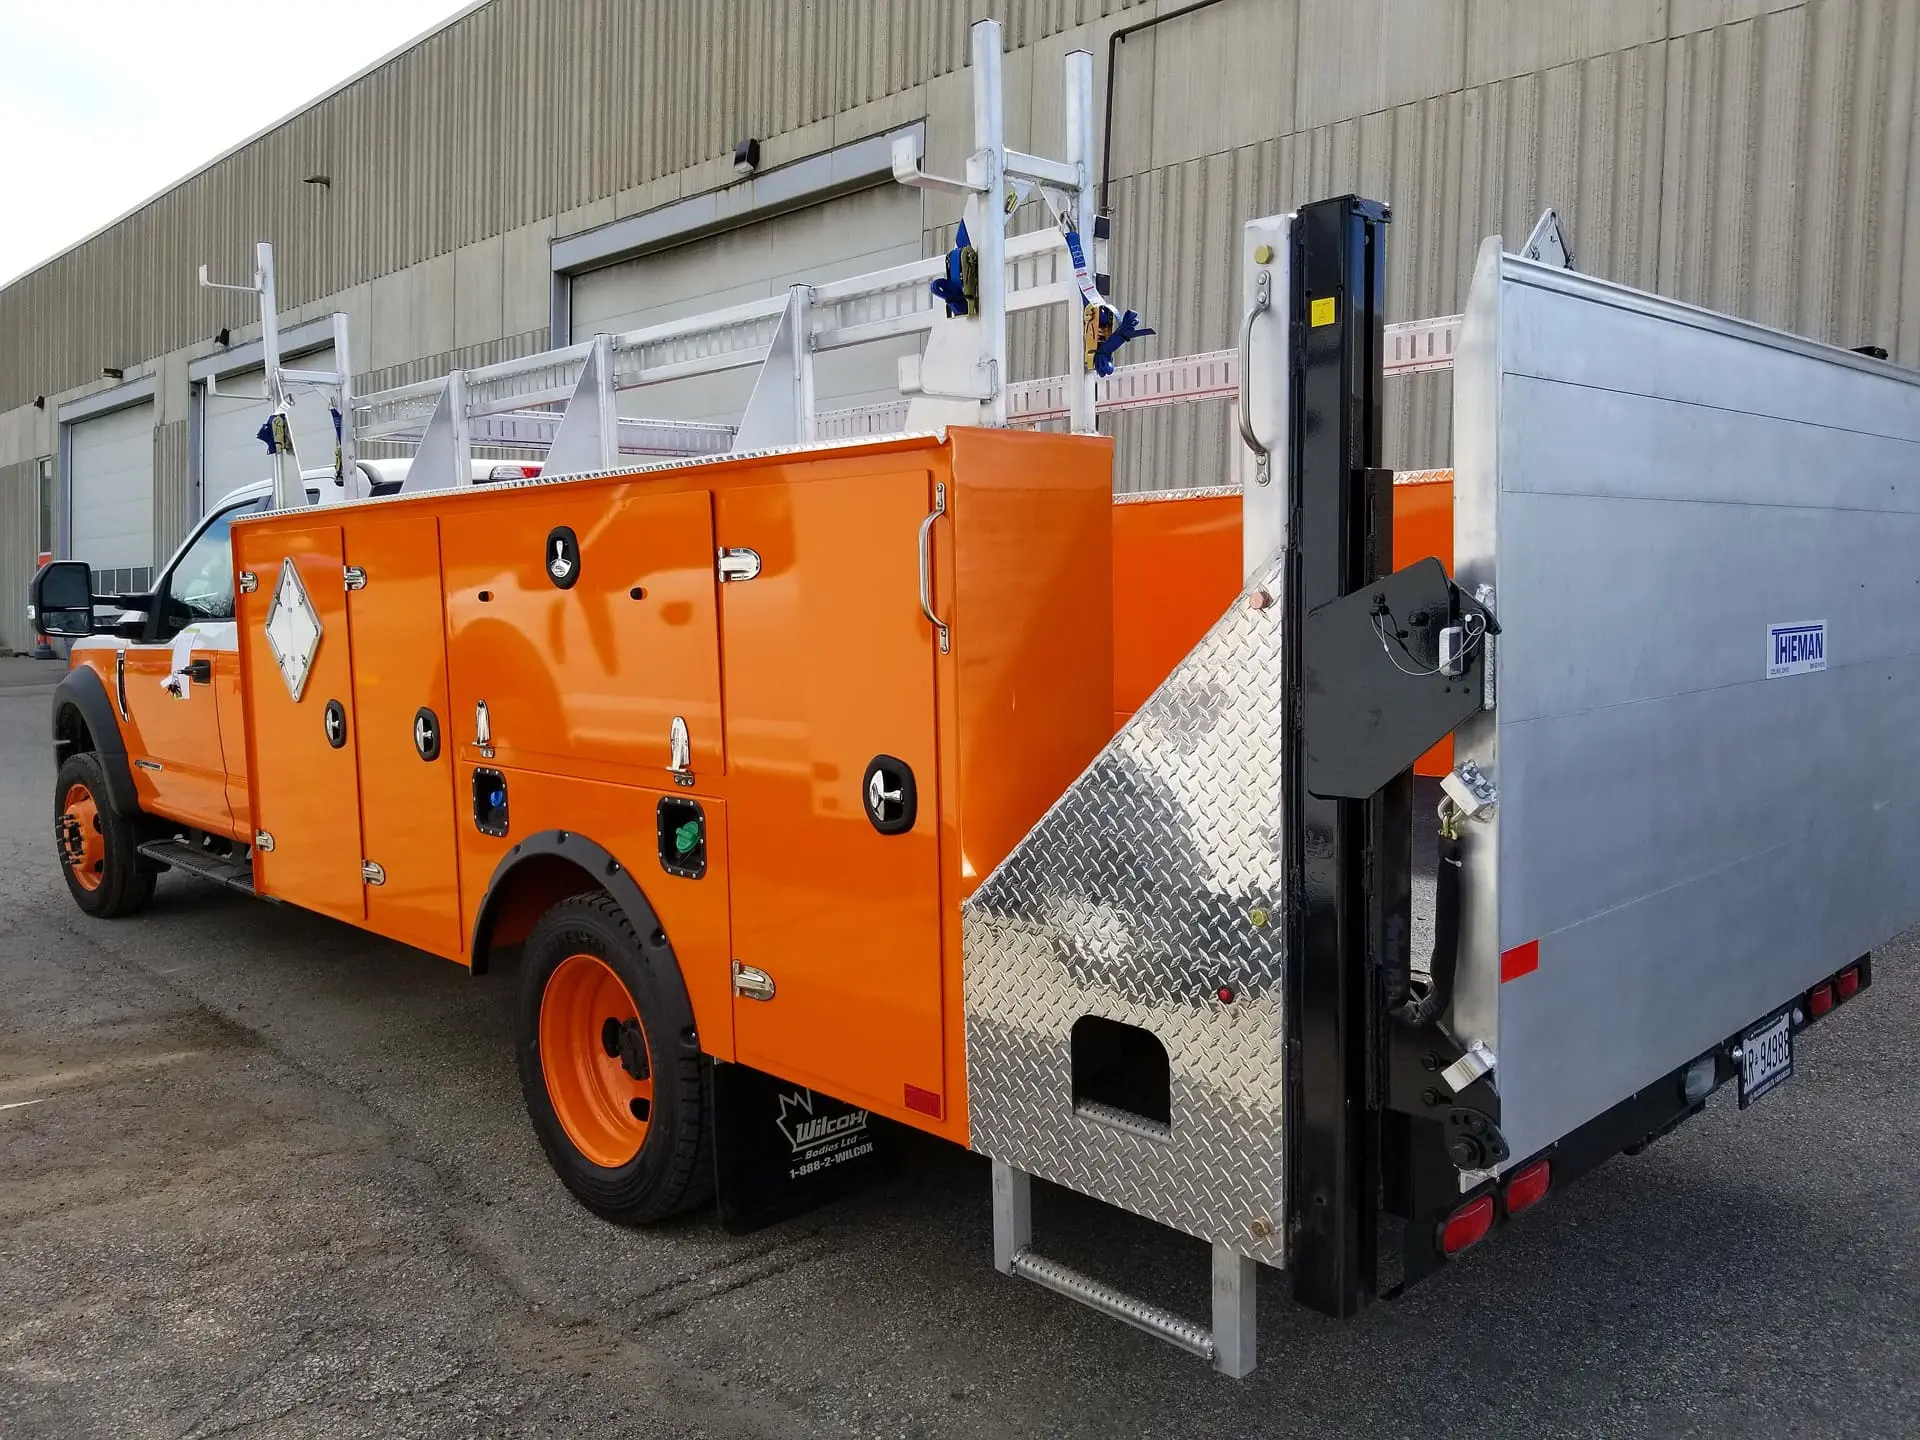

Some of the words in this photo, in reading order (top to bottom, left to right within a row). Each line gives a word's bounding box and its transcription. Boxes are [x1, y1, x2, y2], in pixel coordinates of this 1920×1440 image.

[1772, 625, 1823, 664] THIEMAN
[796, 1110, 864, 1143] Wilcox
[789, 1142, 873, 1178] 1-888-2-WILCOX
[805, 1142, 839, 1160] Bodies
